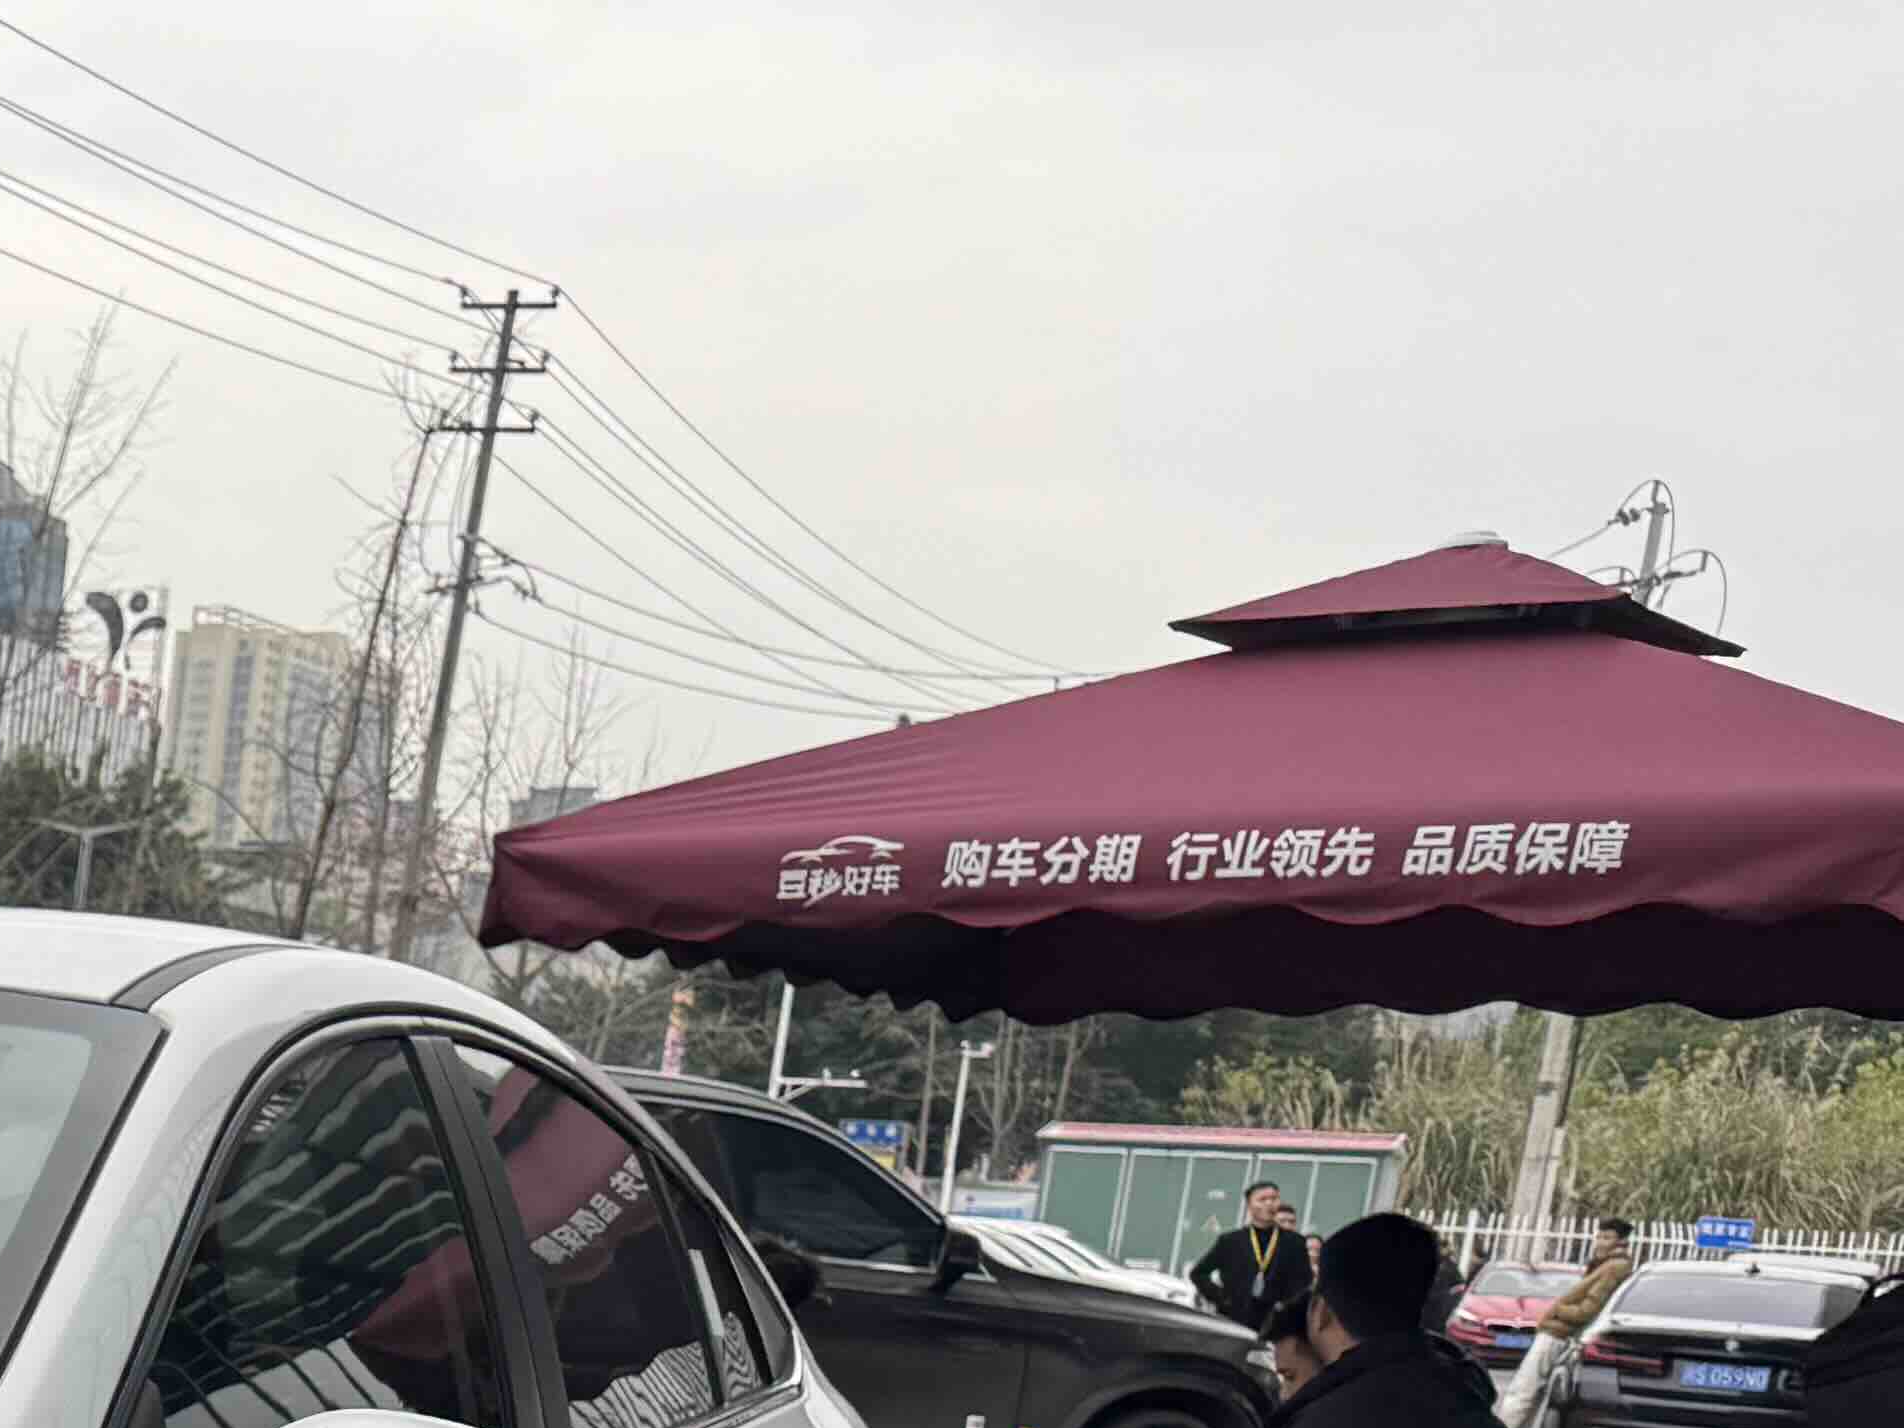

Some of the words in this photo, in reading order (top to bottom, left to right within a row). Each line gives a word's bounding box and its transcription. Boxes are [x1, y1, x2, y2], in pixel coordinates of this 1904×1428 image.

[941, 834, 1142, 888] 购车分期
[1166, 826, 1376, 881] 行业领先
[1400, 820, 1631, 877] 品质保障
